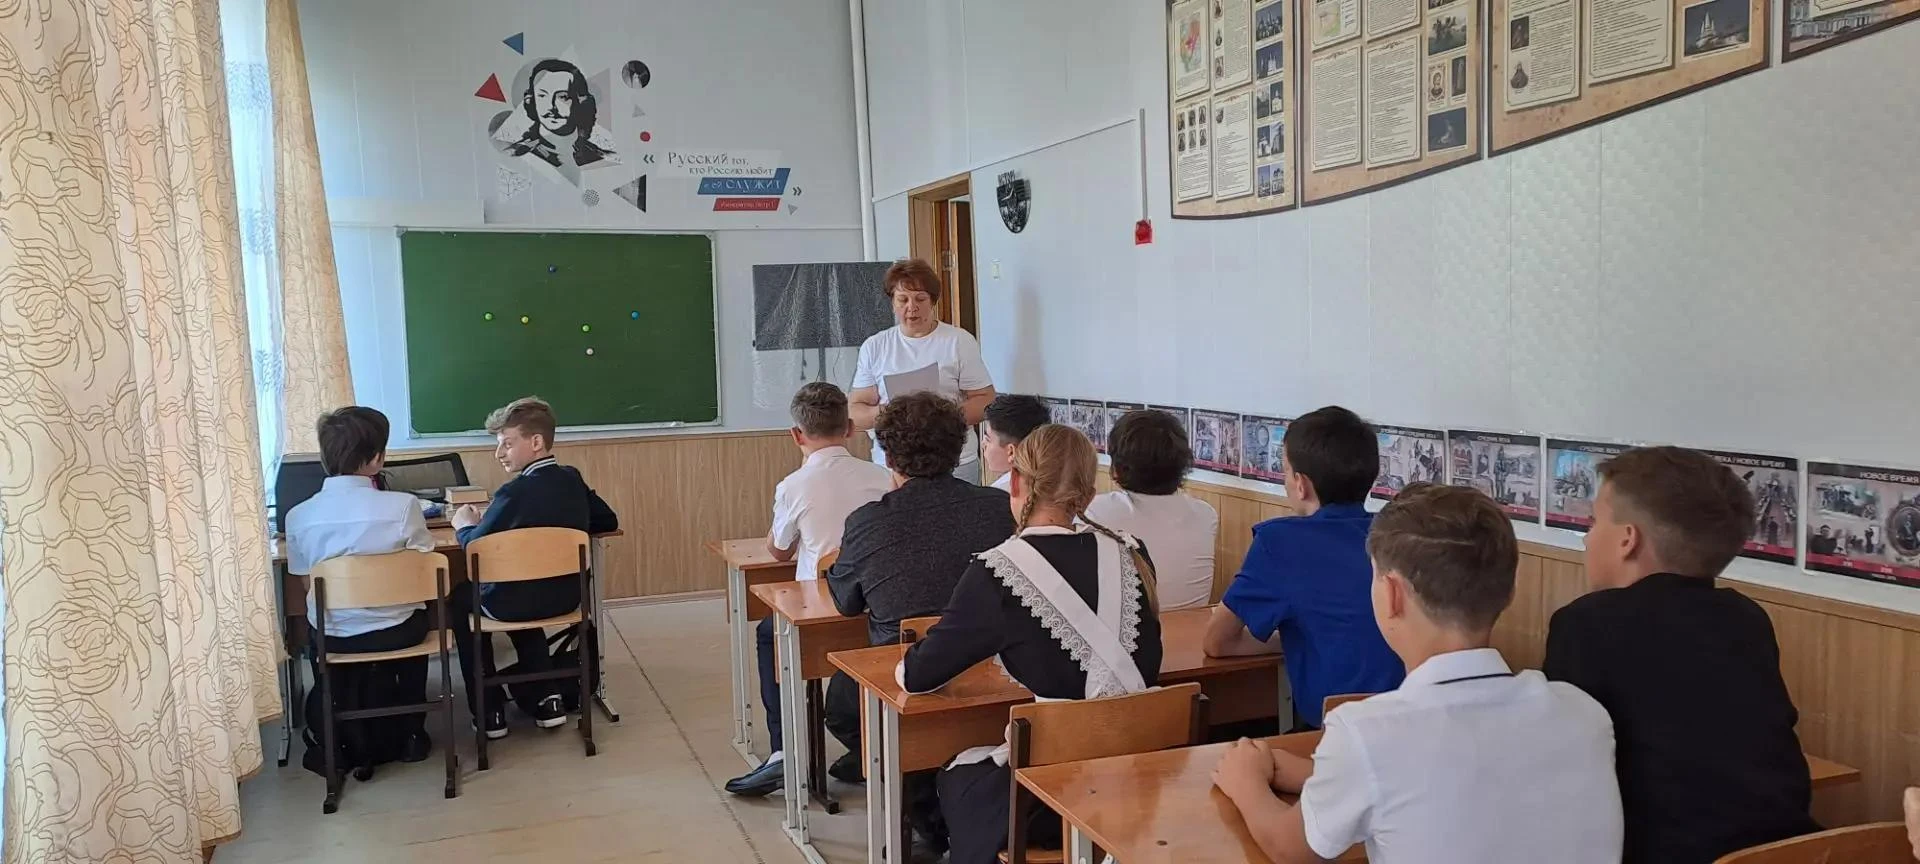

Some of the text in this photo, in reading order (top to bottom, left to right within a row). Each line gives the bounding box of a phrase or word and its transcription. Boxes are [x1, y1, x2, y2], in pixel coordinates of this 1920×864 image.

[668, 151, 728, 168] Русский
[1860, 472, 1919, 484] НОВОЕ ВРЕМЯ
